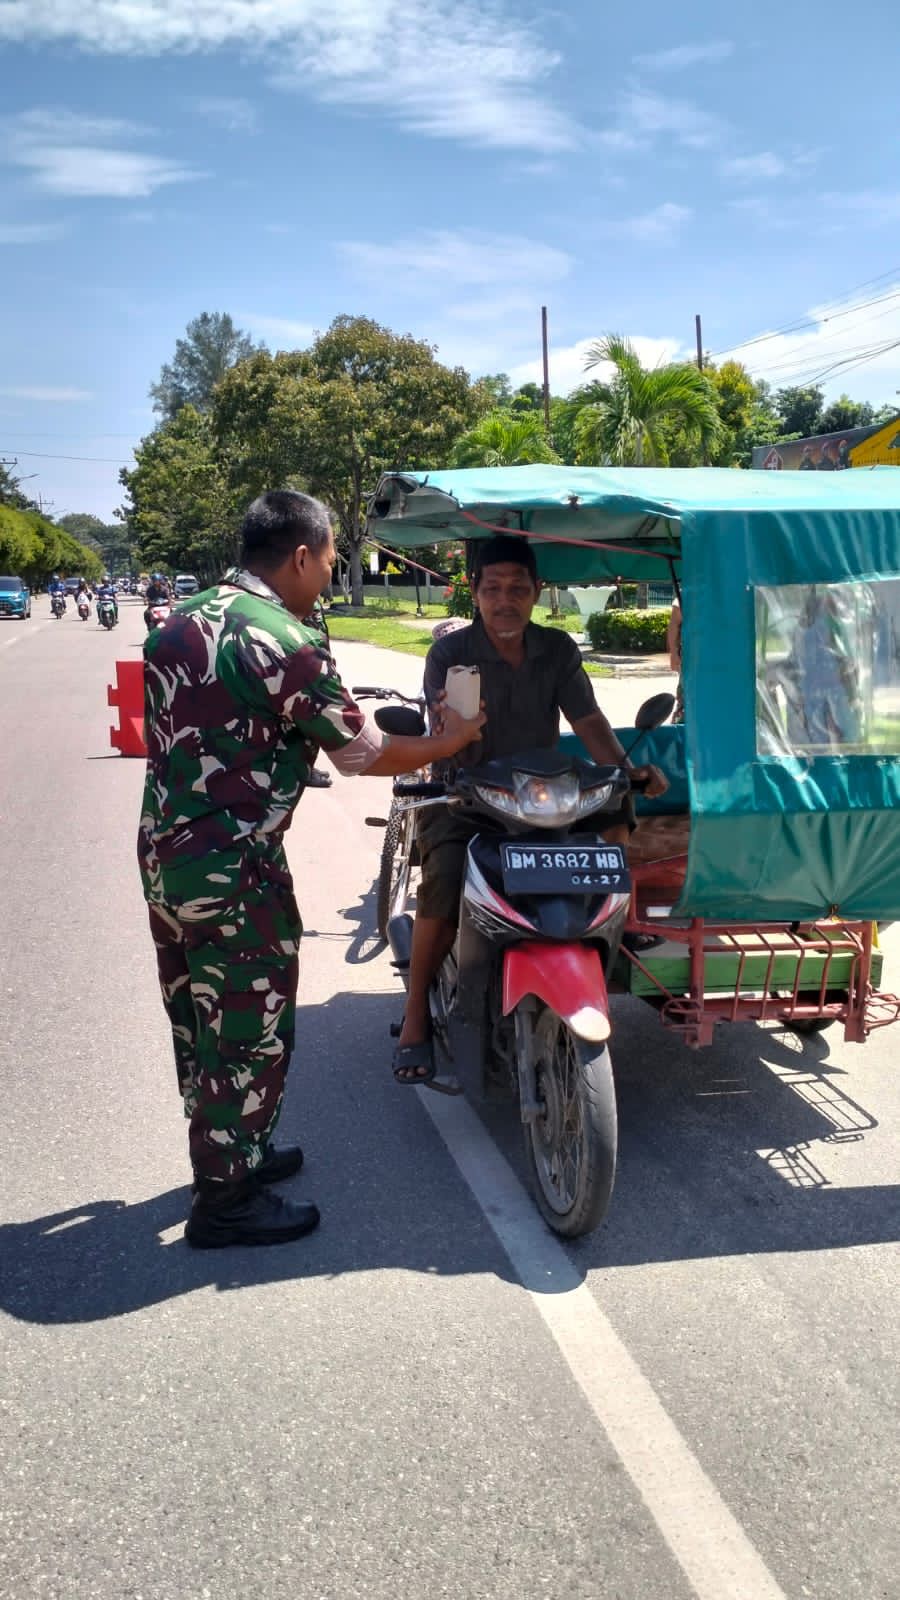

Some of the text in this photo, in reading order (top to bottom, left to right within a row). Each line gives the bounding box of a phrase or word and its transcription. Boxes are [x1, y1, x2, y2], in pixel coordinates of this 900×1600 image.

[511, 852, 619, 868] BM 3682 HB
[571, 875, 621, 885] 04-27
